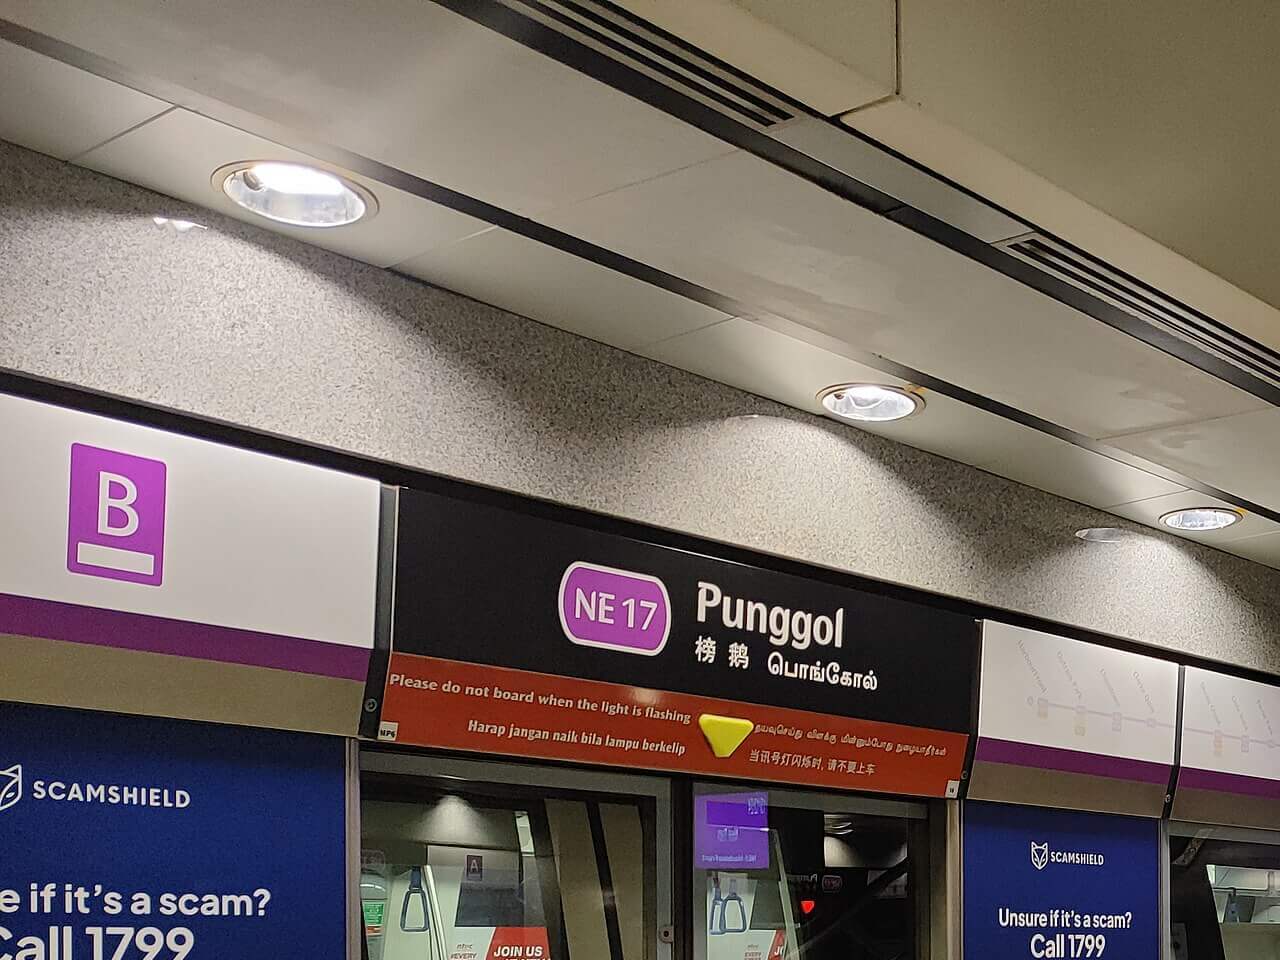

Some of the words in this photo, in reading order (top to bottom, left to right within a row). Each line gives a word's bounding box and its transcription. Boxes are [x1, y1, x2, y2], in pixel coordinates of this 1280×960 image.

[97, 470, 139, 537] B
[574, 587, 615, 625] NE
[622, 597, 657, 631] 17
[696, 580, 844, 650] Punggol
[767, 651, 878, 691] பொங்கோல்
[389, 673, 438, 692] Please
[441, 680, 461, 694] do
[465, 684, 489, 698] not
[493, 687, 535, 705] board
[538, 692, 574, 709] when
[577, 698, 598, 712] the
[601, 701, 629, 716] light
[632, 705, 642, 717] is
[645, 706, 691, 725] flashing
[468, 719, 505, 737] Harap
[507, 722, 549, 741] jangan
[553, 729, 577, 744] naik
[581, 731, 602, 746] bila
[605, 734, 639, 751] lampu
[642, 738, 685, 756] berkelip
[33, 780, 191, 808] SCAMSHIELD
[1050, 850, 1105, 866] SCAMSHIELD
[30, 883, 57, 913] if
[65, 883, 123, 915] it’s
[130, 892, 151, 915] a
[159, 888, 272, 917] scam?
[998, 907, 1047, 928] Unsure
[1050, 909, 1060, 927] if
[1061, 909, 1081, 928] it’s
[1083, 915, 1091, 928] a
[1093, 911, 1133, 929] scam?
[493, 945, 522, 957] JOIN
[526, 945, 543, 957] US
[1030, 933, 1065, 959] Call
[1068, 934, 1105, 959] 1799
